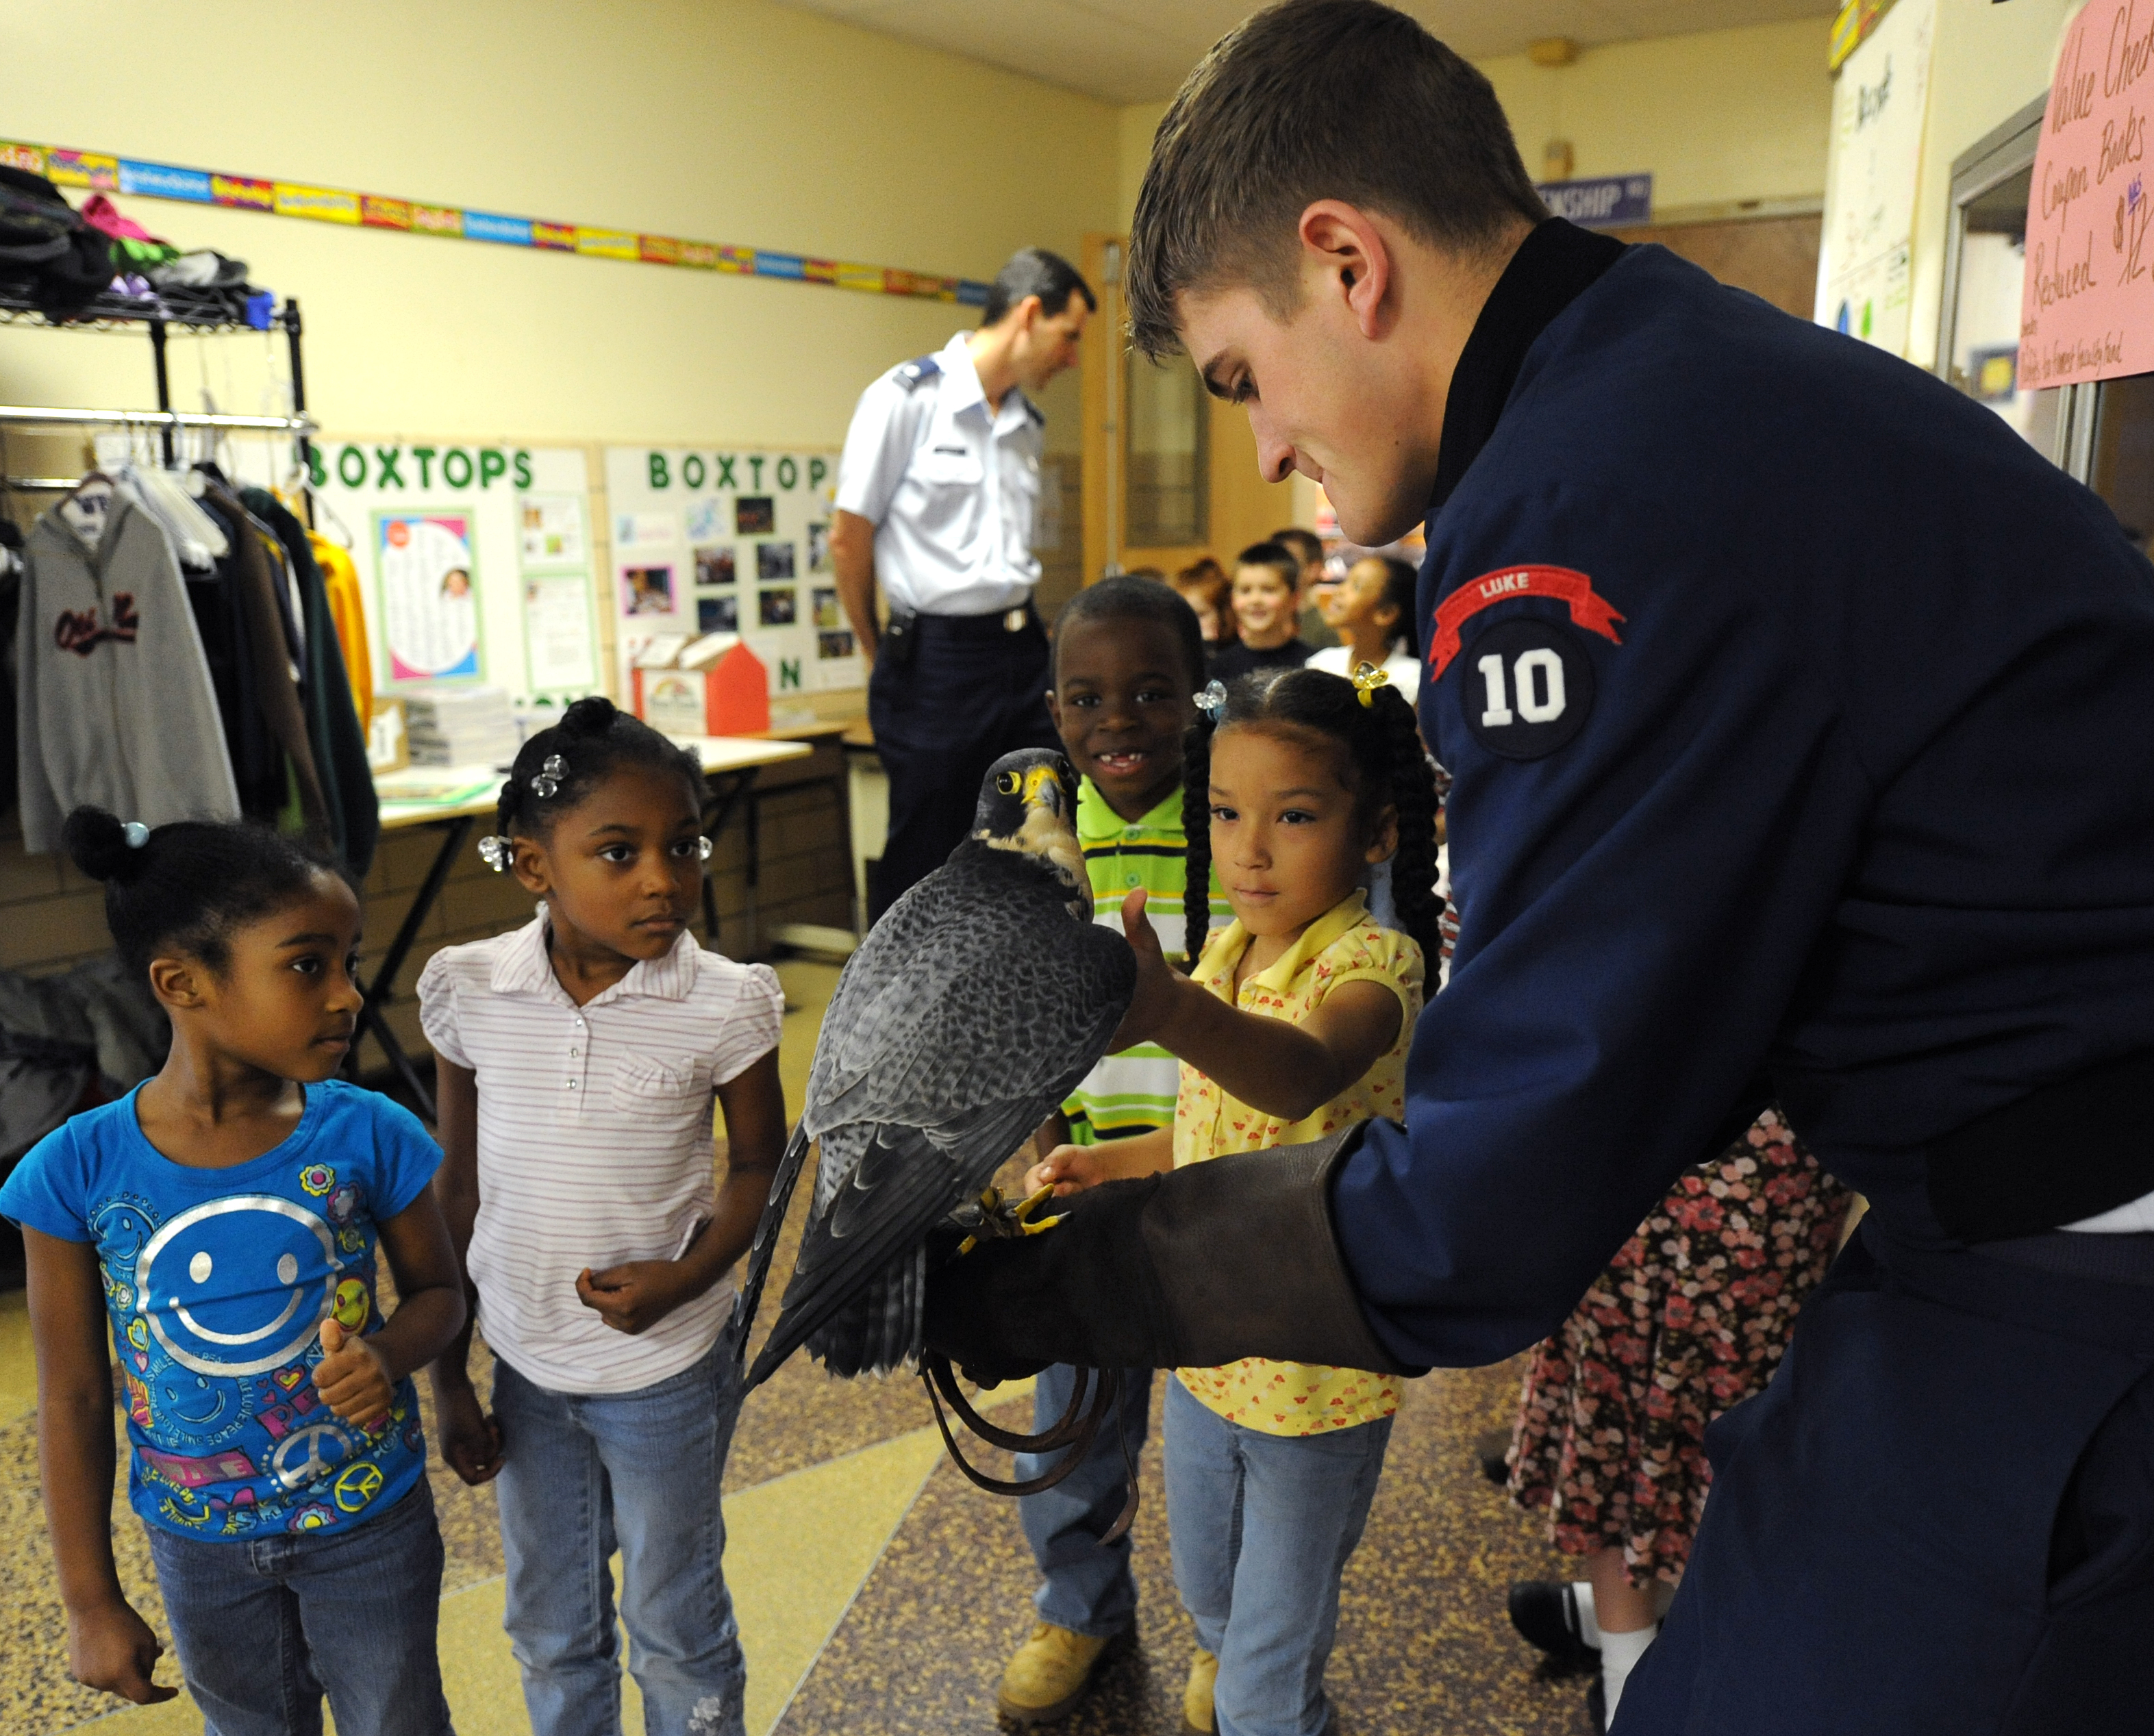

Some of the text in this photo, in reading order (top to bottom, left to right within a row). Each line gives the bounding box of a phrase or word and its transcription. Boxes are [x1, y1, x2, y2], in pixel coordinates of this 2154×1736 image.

[2043, 160, 2088, 232] Coupon
[2097, 105, 2146, 186] Books
[2033, 230, 2096, 312] Reduced
[292, 446, 531, 489] BOXTOPS
[649, 453, 827, 491] BOXTOP
[1479, 572, 1530, 599] LUKE
[1478, 648, 1567, 727] 10
